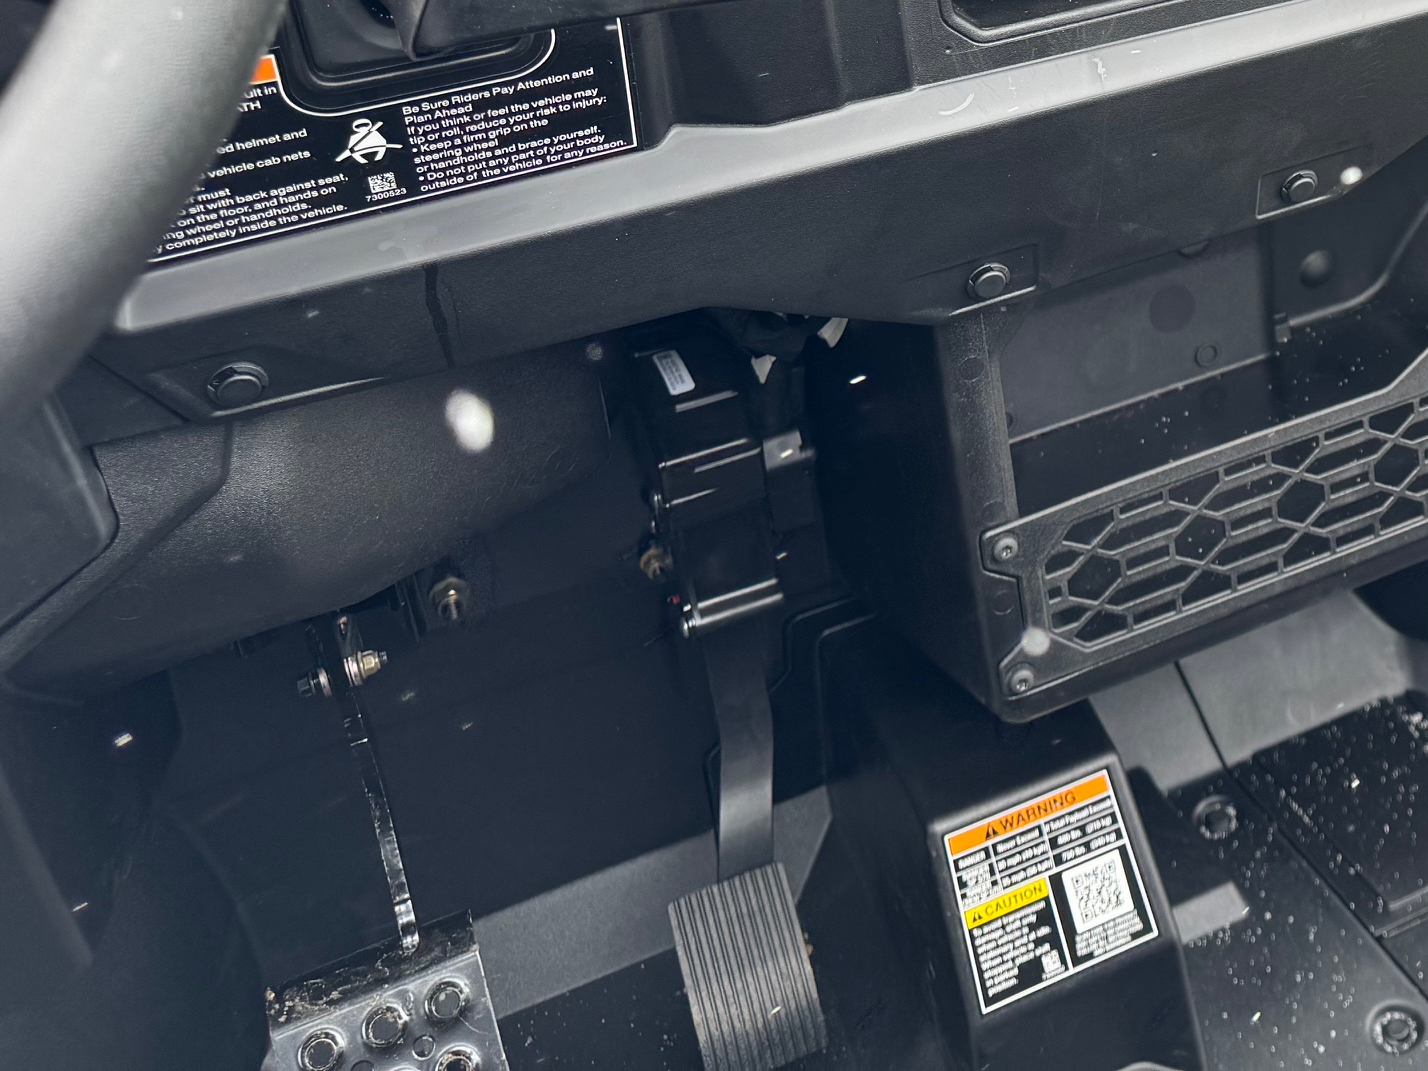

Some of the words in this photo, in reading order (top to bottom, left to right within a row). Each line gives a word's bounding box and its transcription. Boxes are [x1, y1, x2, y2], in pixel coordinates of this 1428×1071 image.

[264, 86, 277, 96] in
[402, 106, 420, 115] Be
[421, 99, 450, 111] Sure
[451, 91, 491, 105] Riders
[492, 85, 514, 96] Pay
[517, 74, 570, 91] Attention
[572, 67, 594, 79] and
[404, 114, 432, 125] Plan
[434, 103, 473, 119] Ahead
[407, 126, 415, 135] If
[417, 123, 440, 135] you
[441, 115, 471, 128] think
[473, 112, 486, 121] or
[487, 105, 509, 118] feel
[510, 103, 530, 113] the
[531, 93, 572, 108] vehicle
[573, 88, 598, 99] may
[409, 136, 426, 145] tip
[427, 132, 440, 141] or
[441, 126, 464, 138] roll,
[465, 118, 507, 133] reduce
[508, 111, 539, 124] your
[538, 106, 557, 116] risk
[558, 104, 571, 112] to
[572, 96, 607, 109] injury:
[235, 134, 281, 150] helmet
[283, 128, 307, 141] and
[414, 148, 462, 164] steering
[463, 138, 499, 153] wheel
[416, 165, 429, 173] or
[430, 150, 493, 170] handholds
[494, 143, 516, 156] and
[517, 138, 551, 150] brace
[552, 125, 601, 144] yourself.
[420, 140, 452, 153] Keep
[462, 132, 486, 143] firm
[488, 127, 511, 139] grip
[512, 123, 528, 132] on
[529, 119, 549, 128] the
[207, 163, 255, 178] vehicle
[256, 156, 281, 168] cab
[282, 151, 311, 162] nets
[420, 176, 464, 192] outside
[466, 171, 478, 181] of
[481, 168, 501, 178] the
[502, 158, 543, 173] vehicle
[546, 154, 562, 163] for
[564, 149, 584, 159] any
[586, 140, 627, 154] reason.
[426, 172, 445, 181] Do
[446, 165, 466, 176] not
[467, 161, 487, 173] put
[488, 157, 509, 167] any
[511, 150, 535, 163] part
[536, 146, 548, 156] of
[549, 141, 575, 155] your
[576, 134, 605, 146] body
[177, 218, 195, 227] on
[196, 213, 218, 223] the
[219, 205, 252, 217] floor,
[254, 198, 278, 210] and
[279, 190, 319, 204] hands
[320, 186, 337, 195] on
[189, 204, 206, 214] sit
[206, 198, 235, 210] with
[235, 191, 268, 204] back
[270, 179, 316, 196] against
[317, 173, 348, 186] seat,
[197, 188, 231, 202] must
[365, 188, 407, 202] 7300523
[165, 229, 236, 250] completely
[238, 220, 277, 233] inside
[278, 215, 299, 224] the
[300, 204, 347, 219] vehicle.
[185, 220, 224, 235] wheel
[225, 218, 240, 226] or
[240, 203, 312, 223] handholds.
[999, 791, 1077, 831] WARNING
[983, 883, 1043, 916] CAUTION
